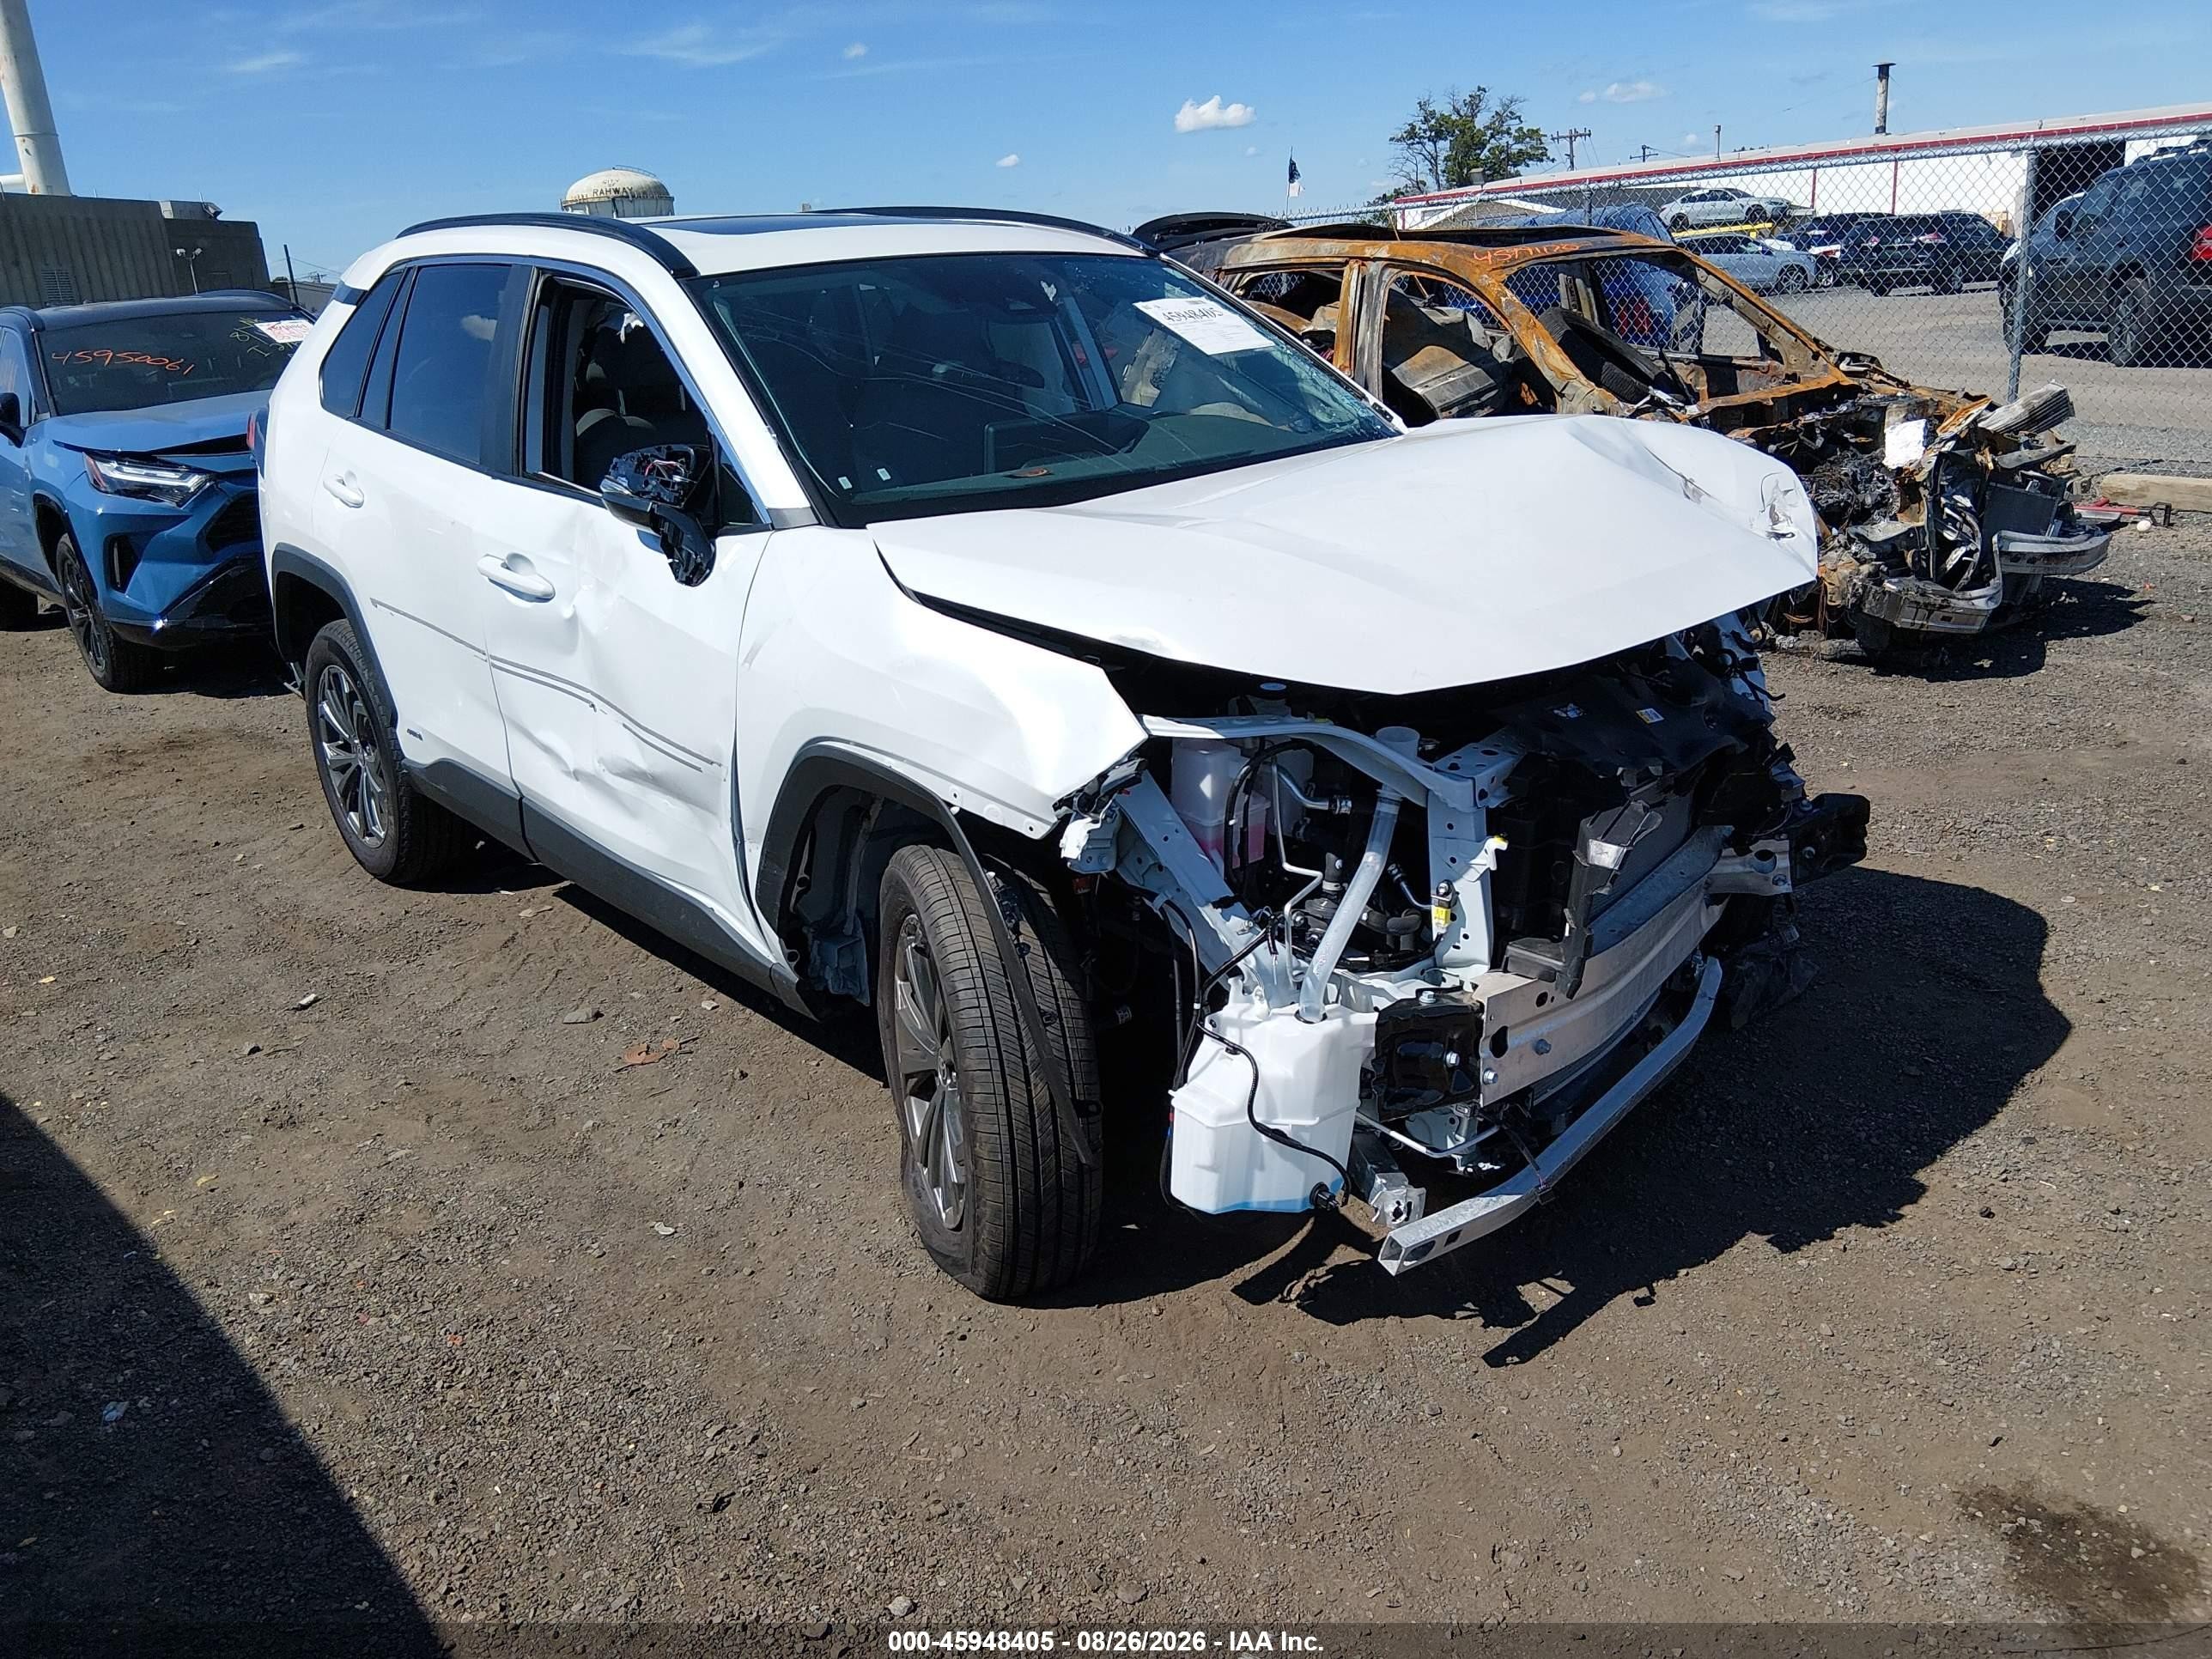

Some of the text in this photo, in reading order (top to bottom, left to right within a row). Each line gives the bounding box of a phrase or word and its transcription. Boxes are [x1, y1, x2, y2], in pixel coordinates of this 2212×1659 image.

[592, 186, 633, 197] RAHWAY
[1162, 307, 1224, 323] 45948405
[52, 349, 195, 375] 45950061
